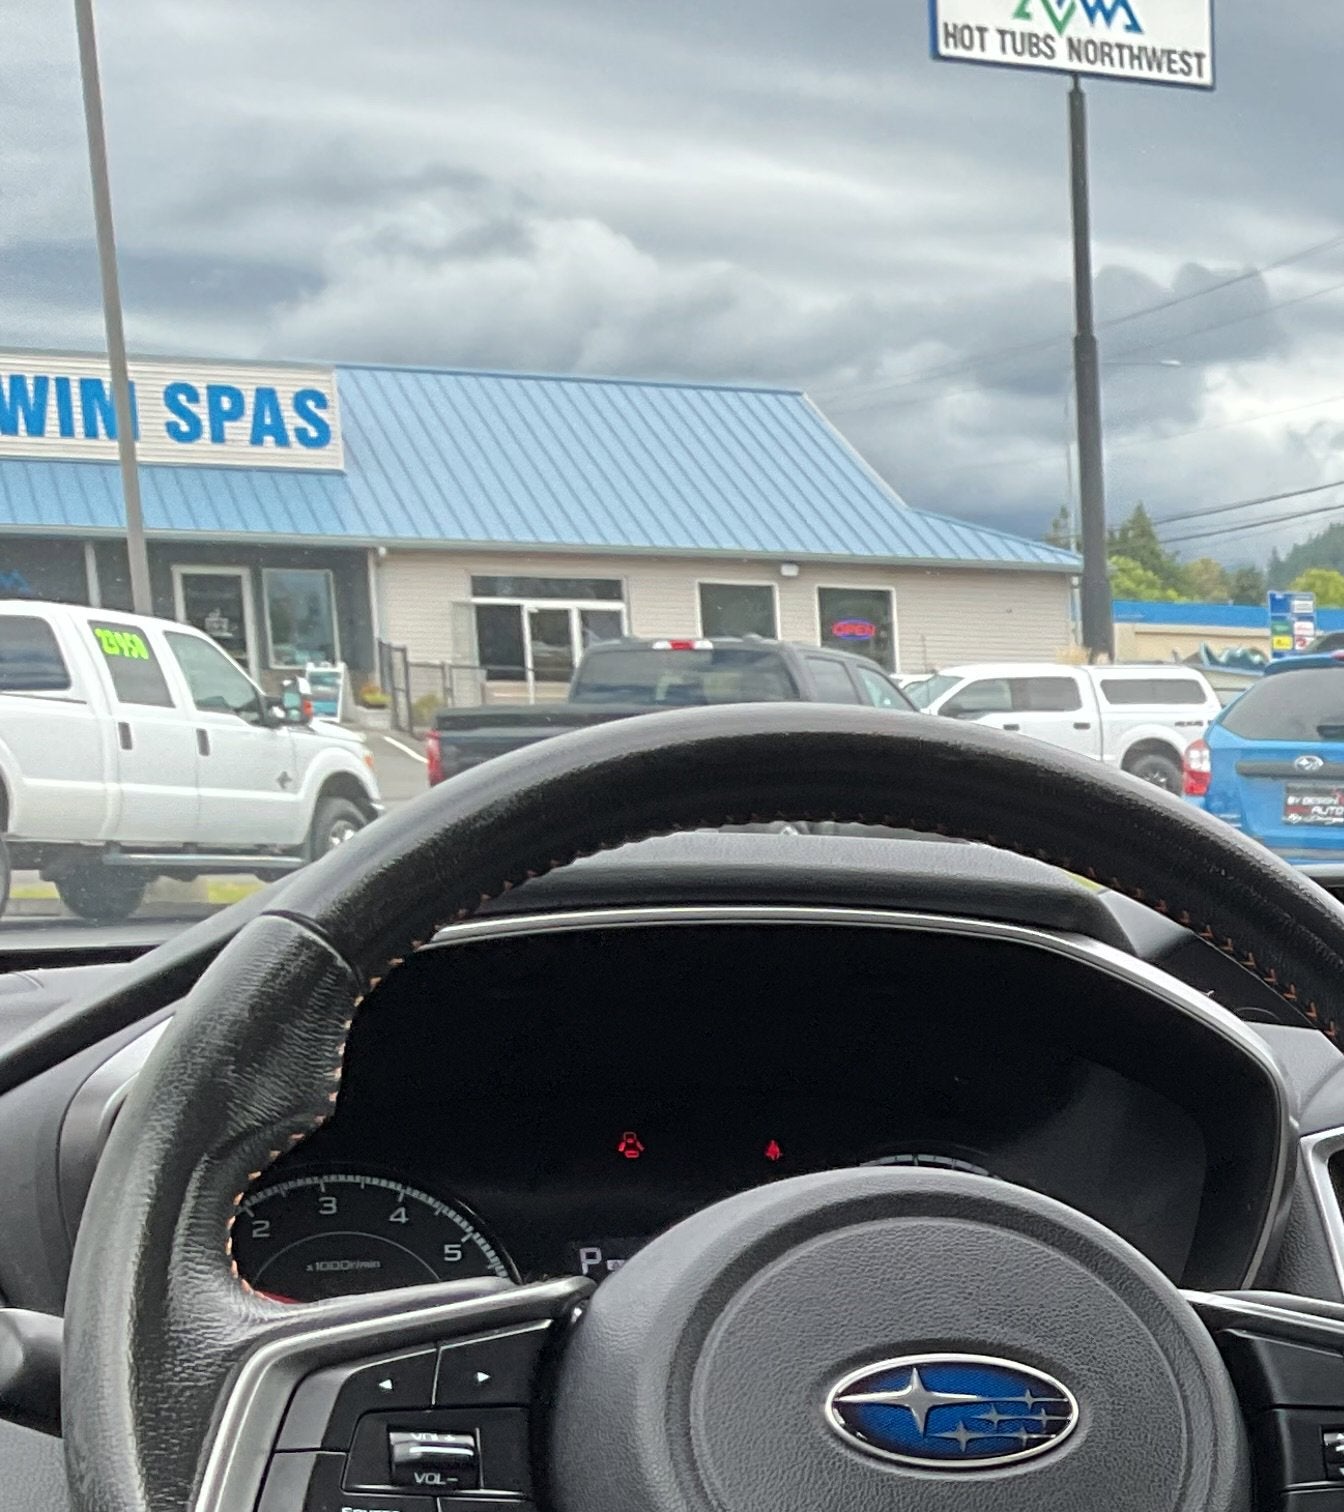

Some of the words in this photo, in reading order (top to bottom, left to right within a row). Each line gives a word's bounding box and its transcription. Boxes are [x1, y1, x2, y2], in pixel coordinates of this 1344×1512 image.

[943, 22, 989, 53] HOT
[997, 29, 1056, 60] TUBS
[1067, 37, 1207, 78] NORTHWEST
[163, 381, 332, 449] SPAS
[1302, 796, 1339, 805] DESIGN
[1311, 806, 1344, 816] AUTO
[318, 1197, 337, 1215] 3
[388, 1207, 410, 1224] 4
[251, 1219, 271, 1238] 2
[443, 1243, 463, 1263] 5
[580, 1247, 602, 1275] P
